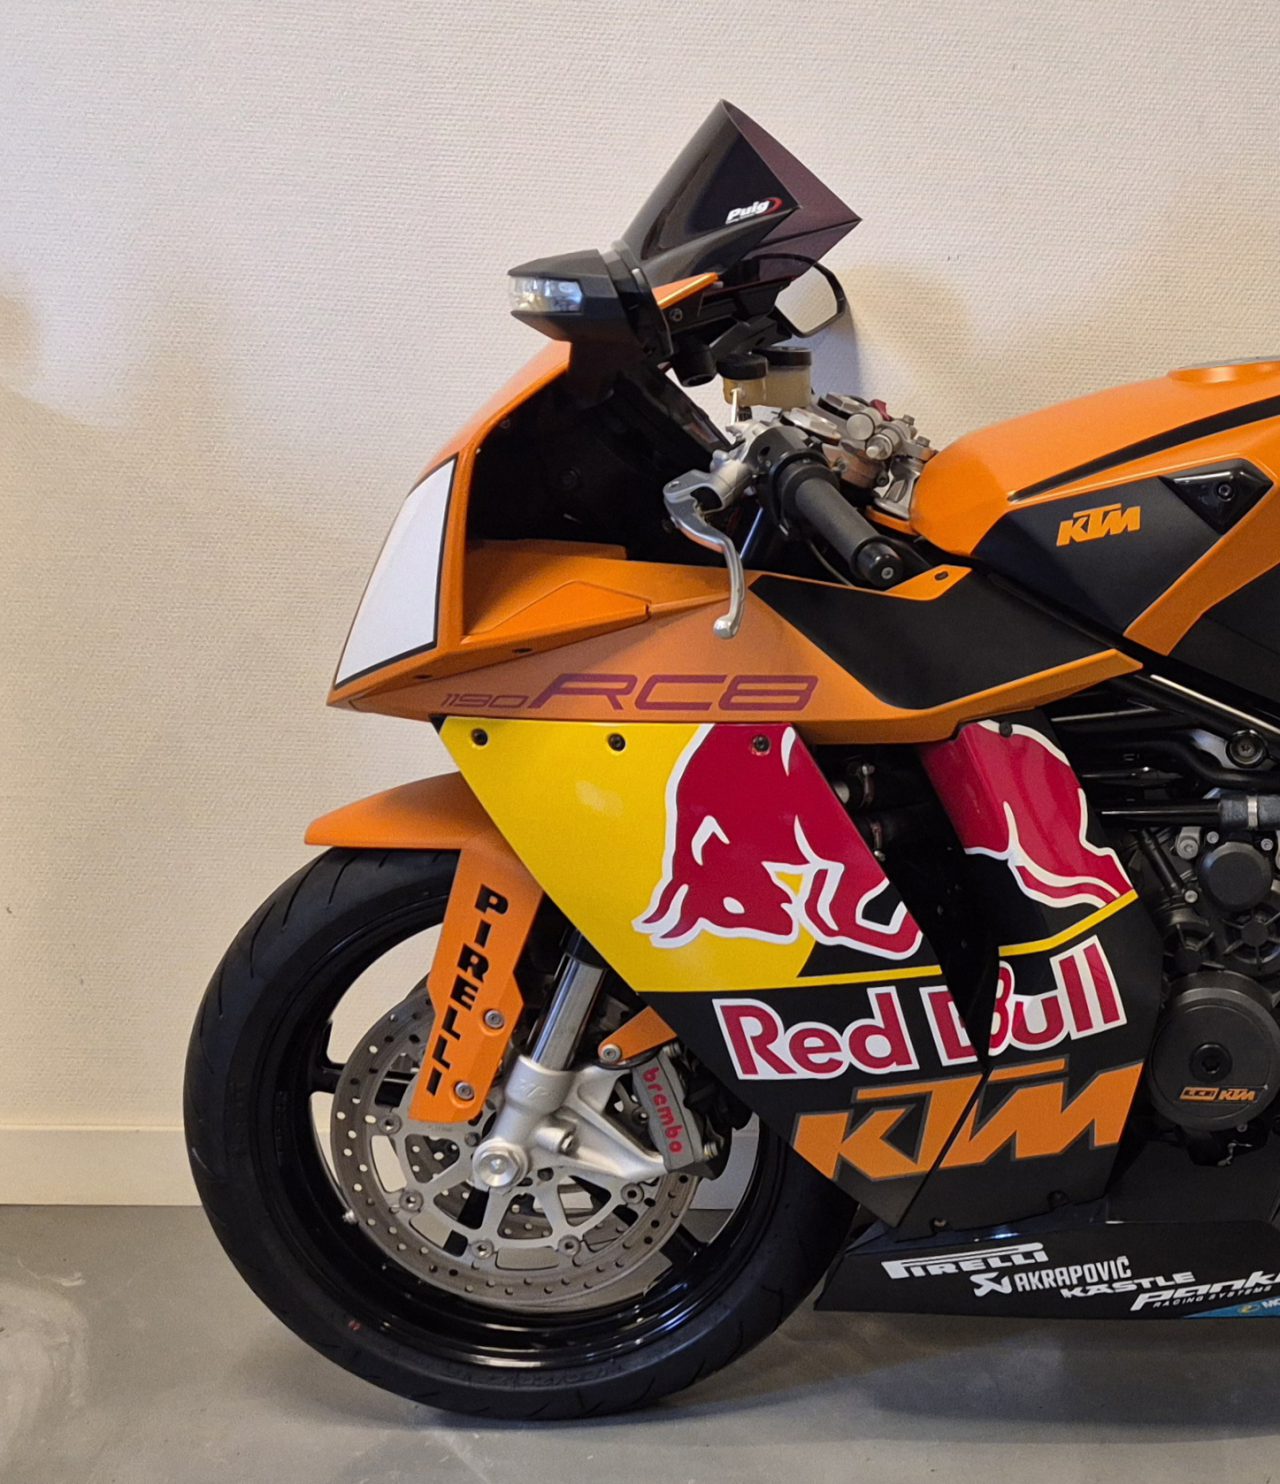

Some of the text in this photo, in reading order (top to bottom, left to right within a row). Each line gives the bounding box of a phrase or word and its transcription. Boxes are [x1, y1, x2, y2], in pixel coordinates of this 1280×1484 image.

[725, 200, 770, 225] Puig
[1056, 502, 1141, 547] KTM
[441, 672, 819, 711] 1190 RC8
[426, 883, 509, 1097] PIRELLI
[712, 935, 1127, 1080] Red Bull
[643, 1066, 684, 1154] brembo
[1219, 1088, 1256, 1101] KTM
[793, 1054, 1145, 1183] KTM
[881, 1242, 1049, 1279] PIRELLI
[1152, 1284, 1273, 1309] RACING SYSTEMS
